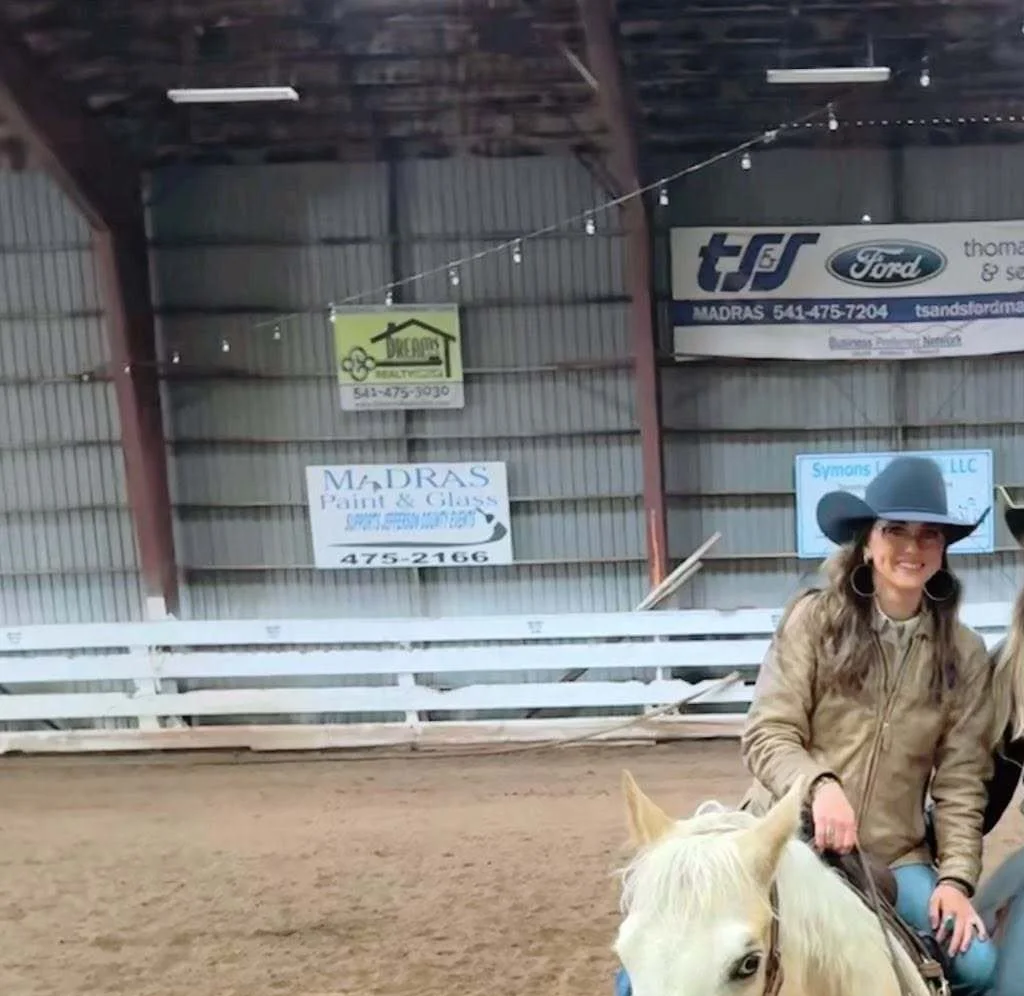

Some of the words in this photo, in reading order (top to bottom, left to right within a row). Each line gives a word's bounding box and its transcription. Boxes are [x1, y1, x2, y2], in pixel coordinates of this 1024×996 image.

[850, 247, 922, 279] Ford
[981, 263, 999, 282] &
[693, 305, 764, 320] MADRAS
[773, 304, 888, 320] 541-475-7204
[354, 385, 450, 400] 541-475-3030
[324, 466, 490, 491] MADRAS
[812, 462, 871, 481] Symons
[950, 458, 977, 473] LLC
[320, 493, 385, 510] Paint
[396, 493, 414, 508] &
[426, 491, 498, 508] Glass
[340, 551, 490, 565] 475-2166
